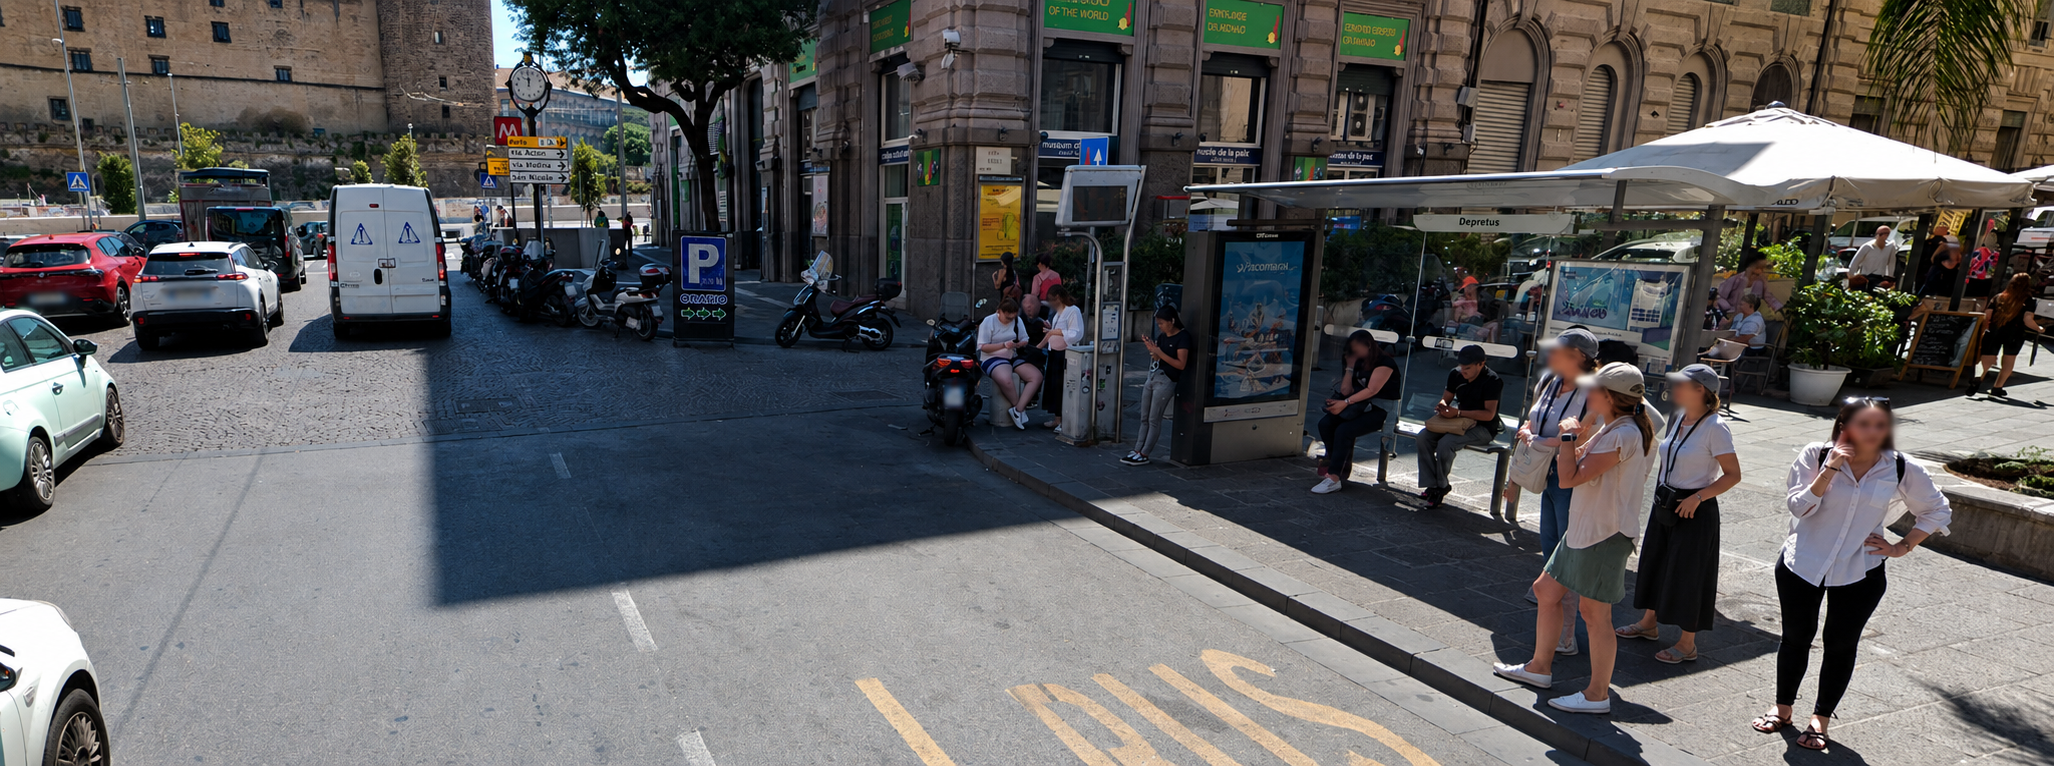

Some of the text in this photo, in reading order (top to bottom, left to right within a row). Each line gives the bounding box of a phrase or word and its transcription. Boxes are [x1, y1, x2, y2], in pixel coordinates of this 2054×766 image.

[1048, 5, 1109, 21] OF THE WORLD
[498, 122, 518, 139] M
[688, 243, 720, 284] P
[679, 293, 728, 305] ORARIO
